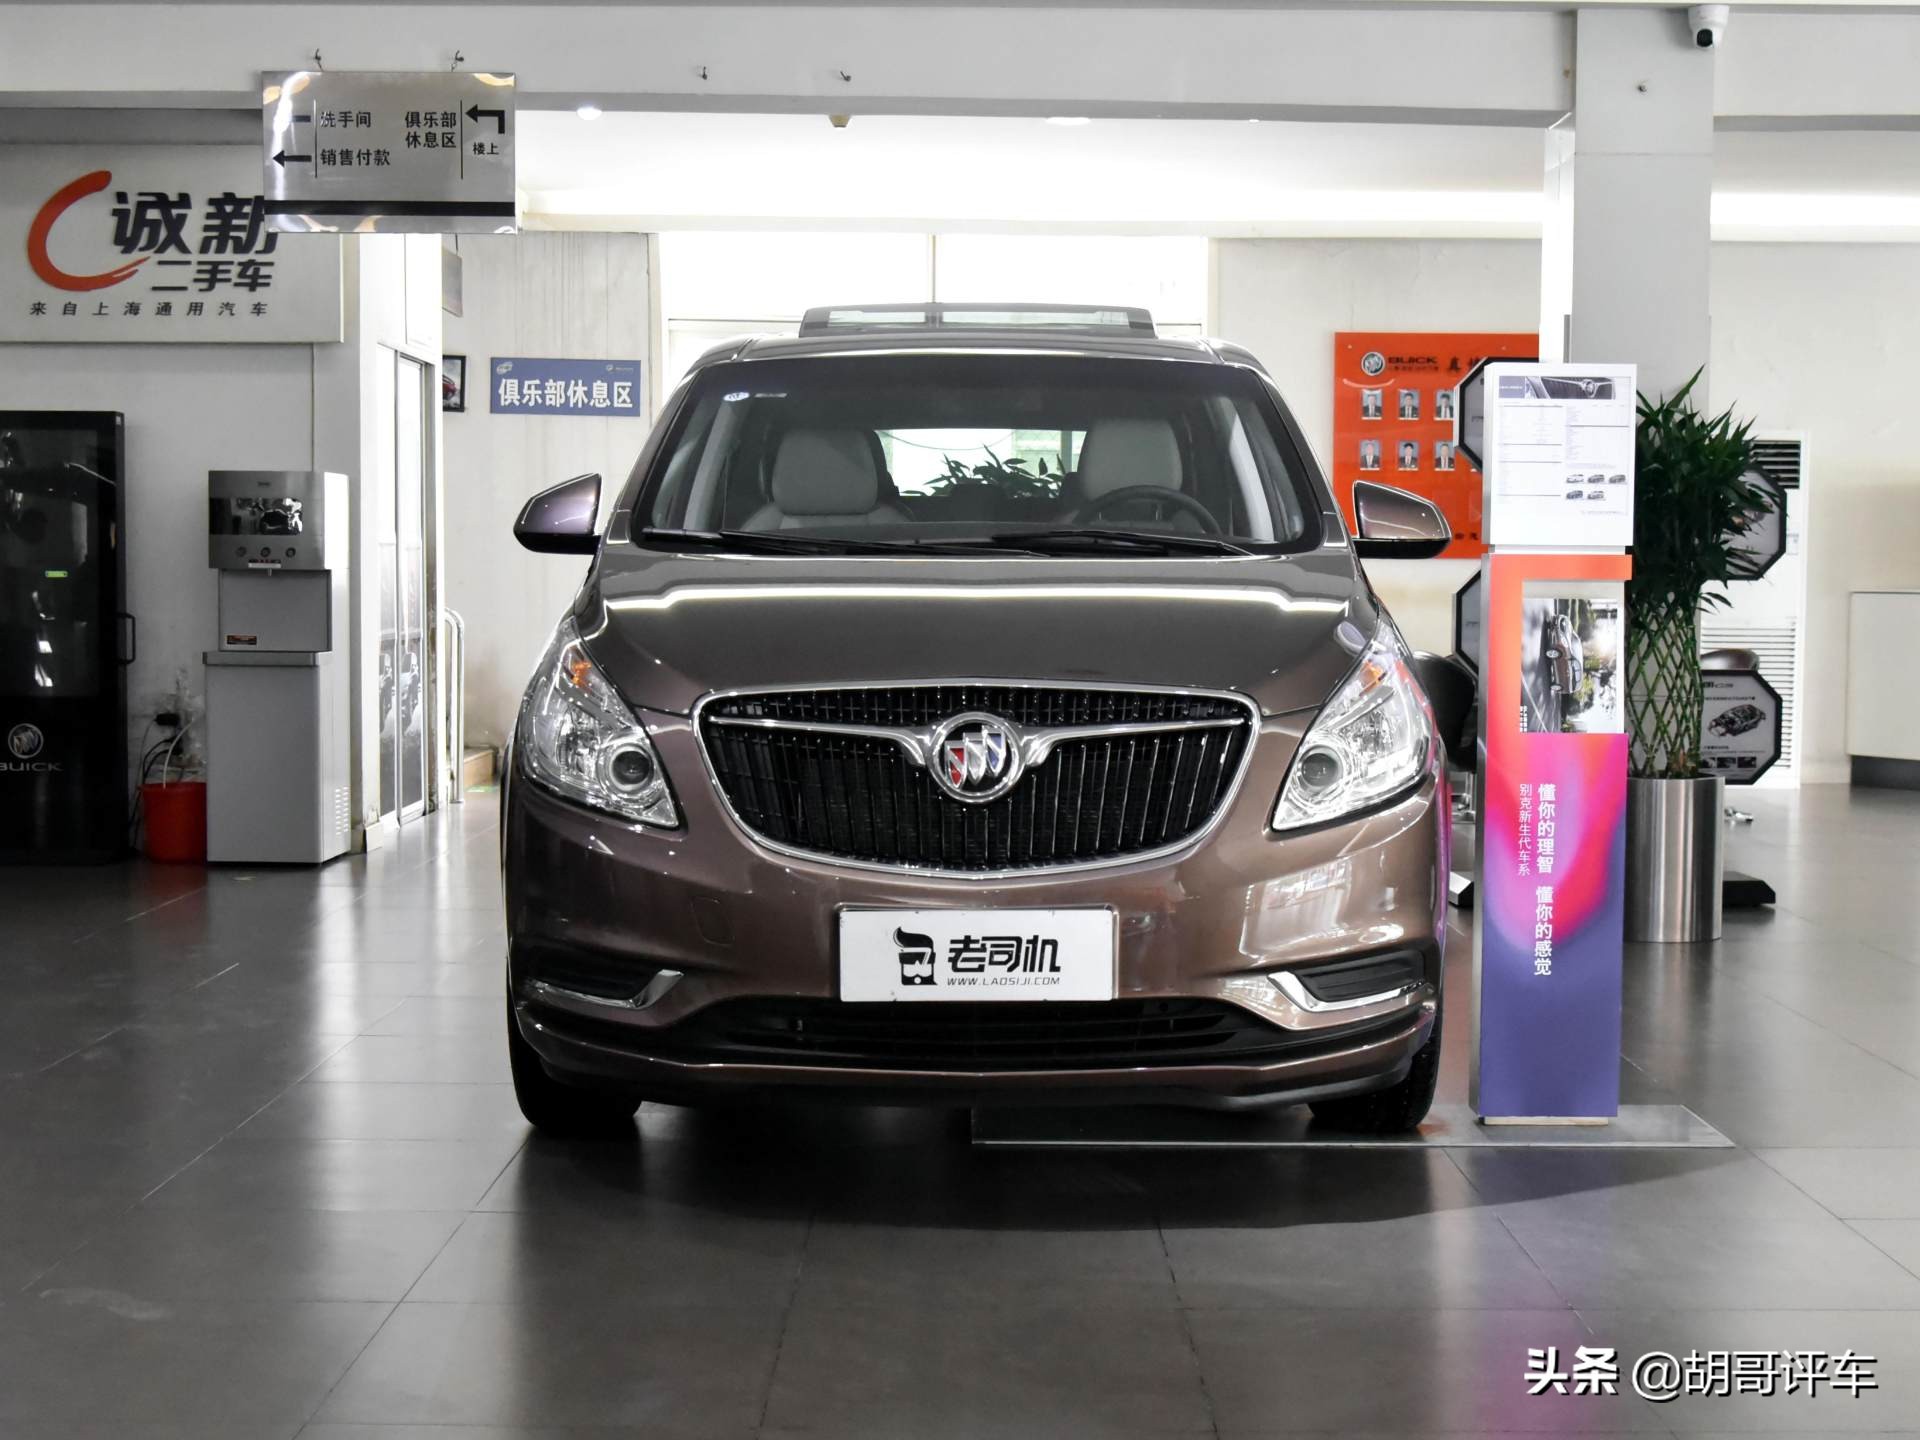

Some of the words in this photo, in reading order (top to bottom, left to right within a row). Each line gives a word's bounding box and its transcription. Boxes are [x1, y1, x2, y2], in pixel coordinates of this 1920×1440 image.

[320, 111, 371, 128] 洗手间
[405, 111, 457, 128] 俱乐部
[405, 131, 457, 149] 休息区
[472, 142, 499, 156] 楼上
[320, 148, 390, 166] 销售付款
[111, 191, 279, 254] 诚新
[151, 259, 275, 292] 二手车
[30, 301, 268, 317] 来自上海通用汽车
[498, 377, 633, 409] 俱乐部休息区
[1518, 783, 1533, 876] 别克新生代车系
[1536, 783, 1556, 874] 懂你的理智
[1533, 886, 1554, 976] 懂你的感觉
[947, 934, 1061, 973] 老司机
[947, 976, 1061, 986] WWW.LAOSIJI.COM
